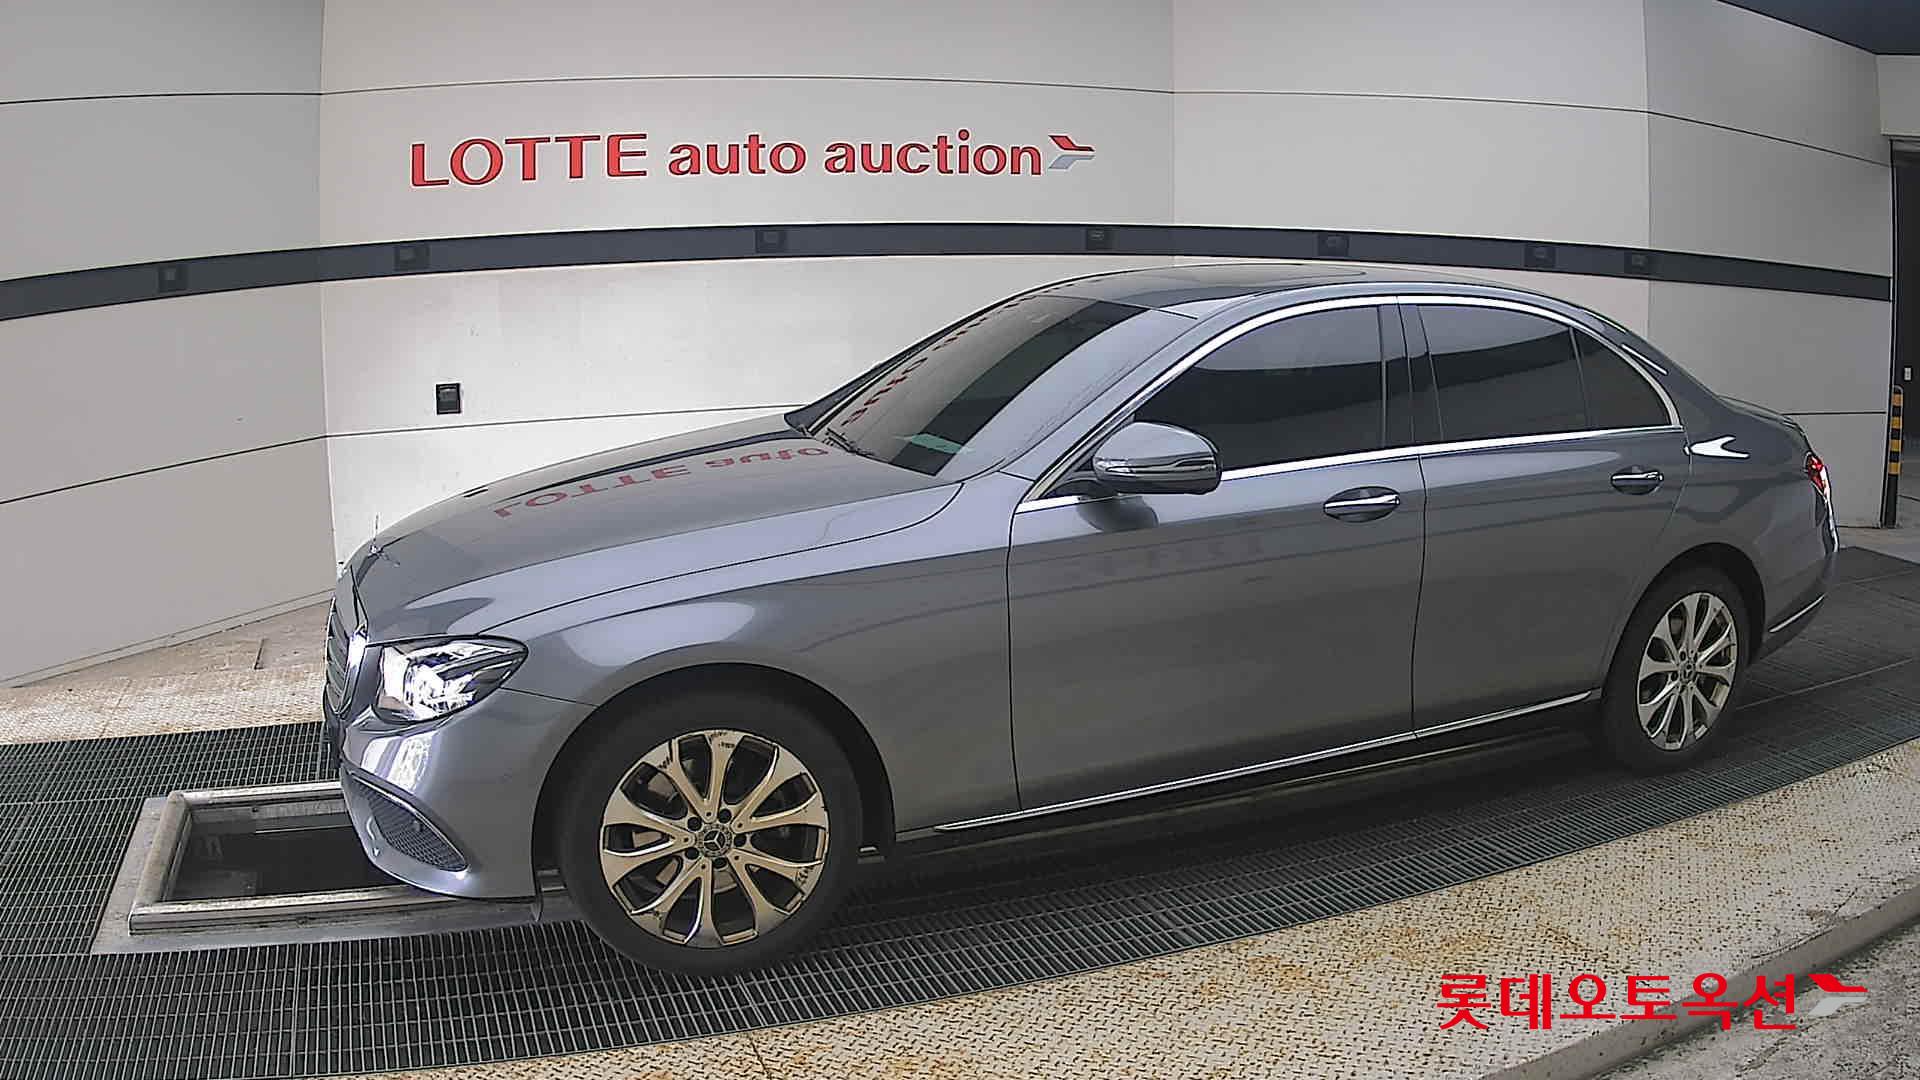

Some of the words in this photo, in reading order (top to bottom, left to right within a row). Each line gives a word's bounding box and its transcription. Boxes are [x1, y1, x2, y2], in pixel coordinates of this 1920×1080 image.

[410, 133, 647, 187] LOTTE
[668, 134, 807, 175] auto
[824, 129, 1042, 175] auction
